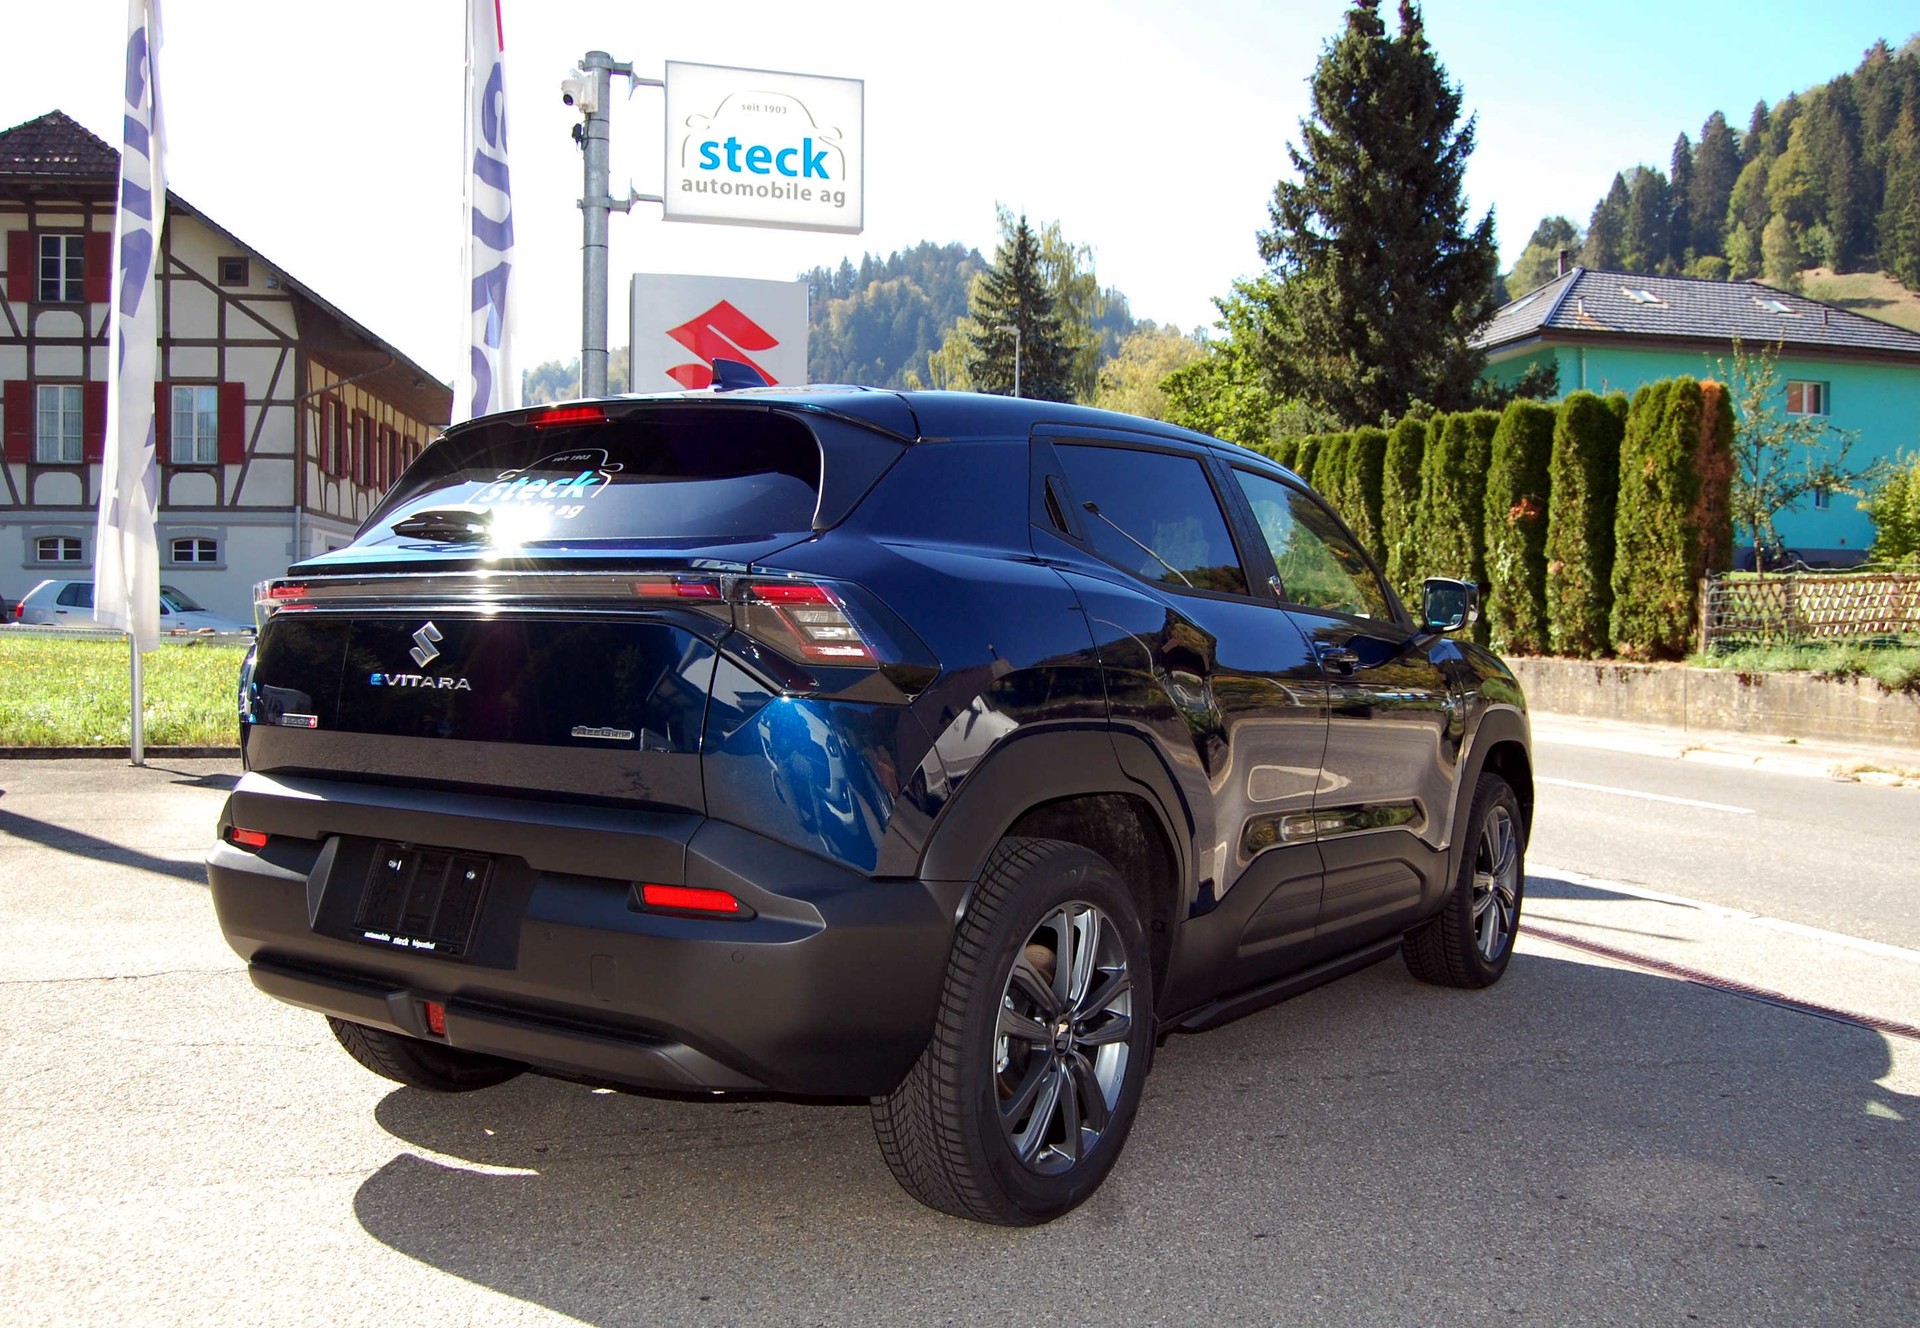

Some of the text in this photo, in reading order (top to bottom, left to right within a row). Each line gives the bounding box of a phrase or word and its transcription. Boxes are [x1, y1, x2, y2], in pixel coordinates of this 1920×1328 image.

[741, 103, 787, 114] seit 1903
[699, 136, 830, 180] steck
[681, 178, 846, 208] automobile ag
[479, 470, 600, 502] steck
[556, 505, 584, 519] ag
